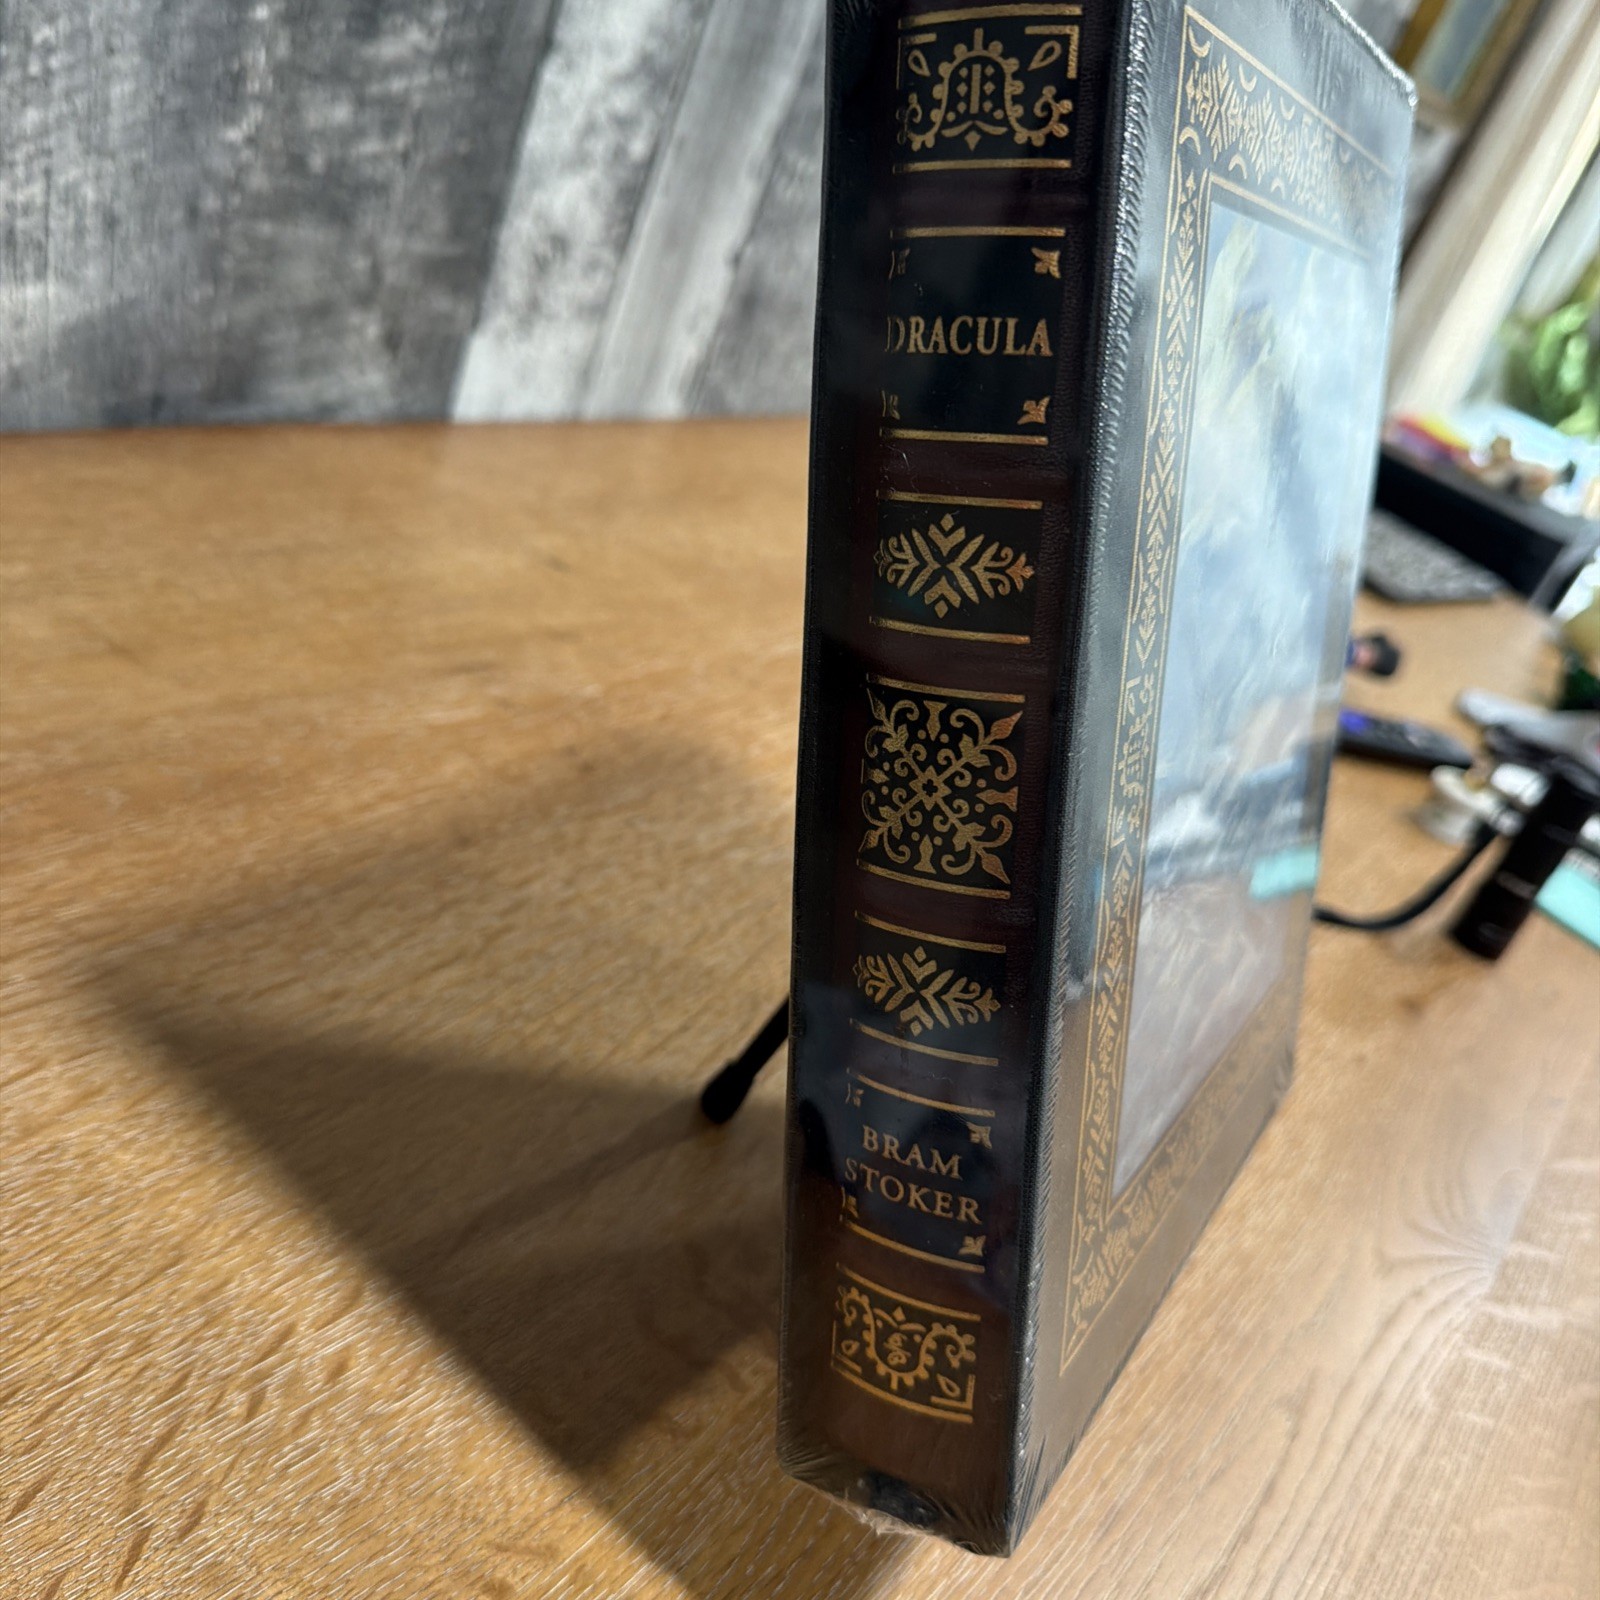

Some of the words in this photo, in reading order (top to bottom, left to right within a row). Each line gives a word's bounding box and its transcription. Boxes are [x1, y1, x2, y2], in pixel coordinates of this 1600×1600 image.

[885, 315, 1053, 357] DRACULA
[862, 1124, 963, 1181] BRAM
[844, 1157, 983, 1226] STOKER
